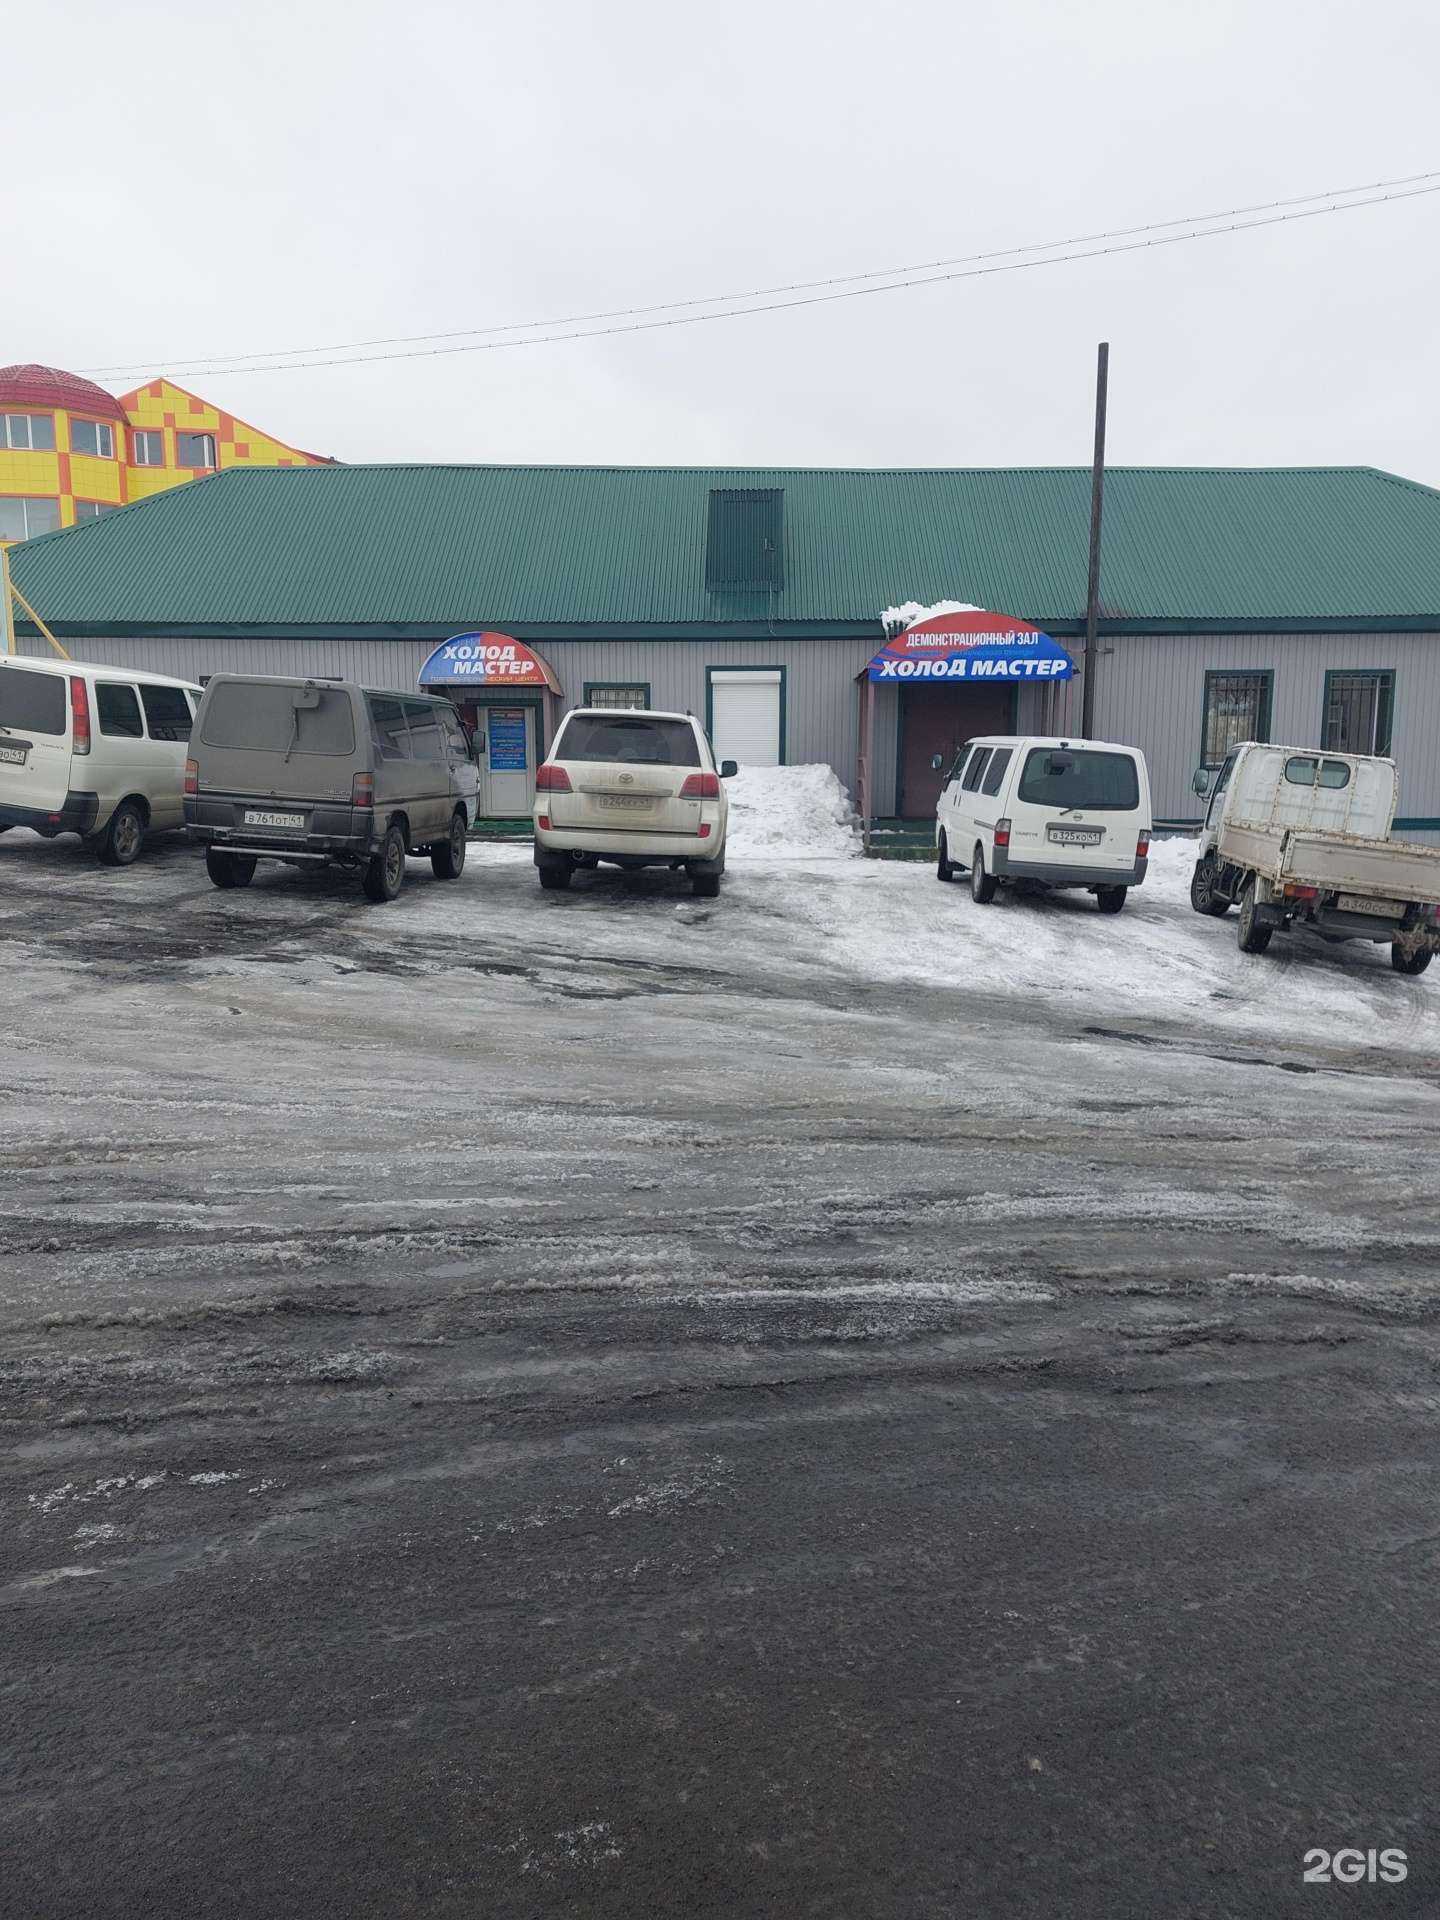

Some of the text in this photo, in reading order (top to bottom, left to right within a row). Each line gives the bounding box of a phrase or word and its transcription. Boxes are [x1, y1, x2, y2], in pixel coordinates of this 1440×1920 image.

[906, 631, 1039, 647] ДЕМОНСТРАЦИОННЫЙ ЗАЛ
[443, 645, 516, 660] ХОЛОД
[453, 661, 535, 675] МАСТЕР
[880, 659, 1068, 677] ХОЛОД МАСТЕР
